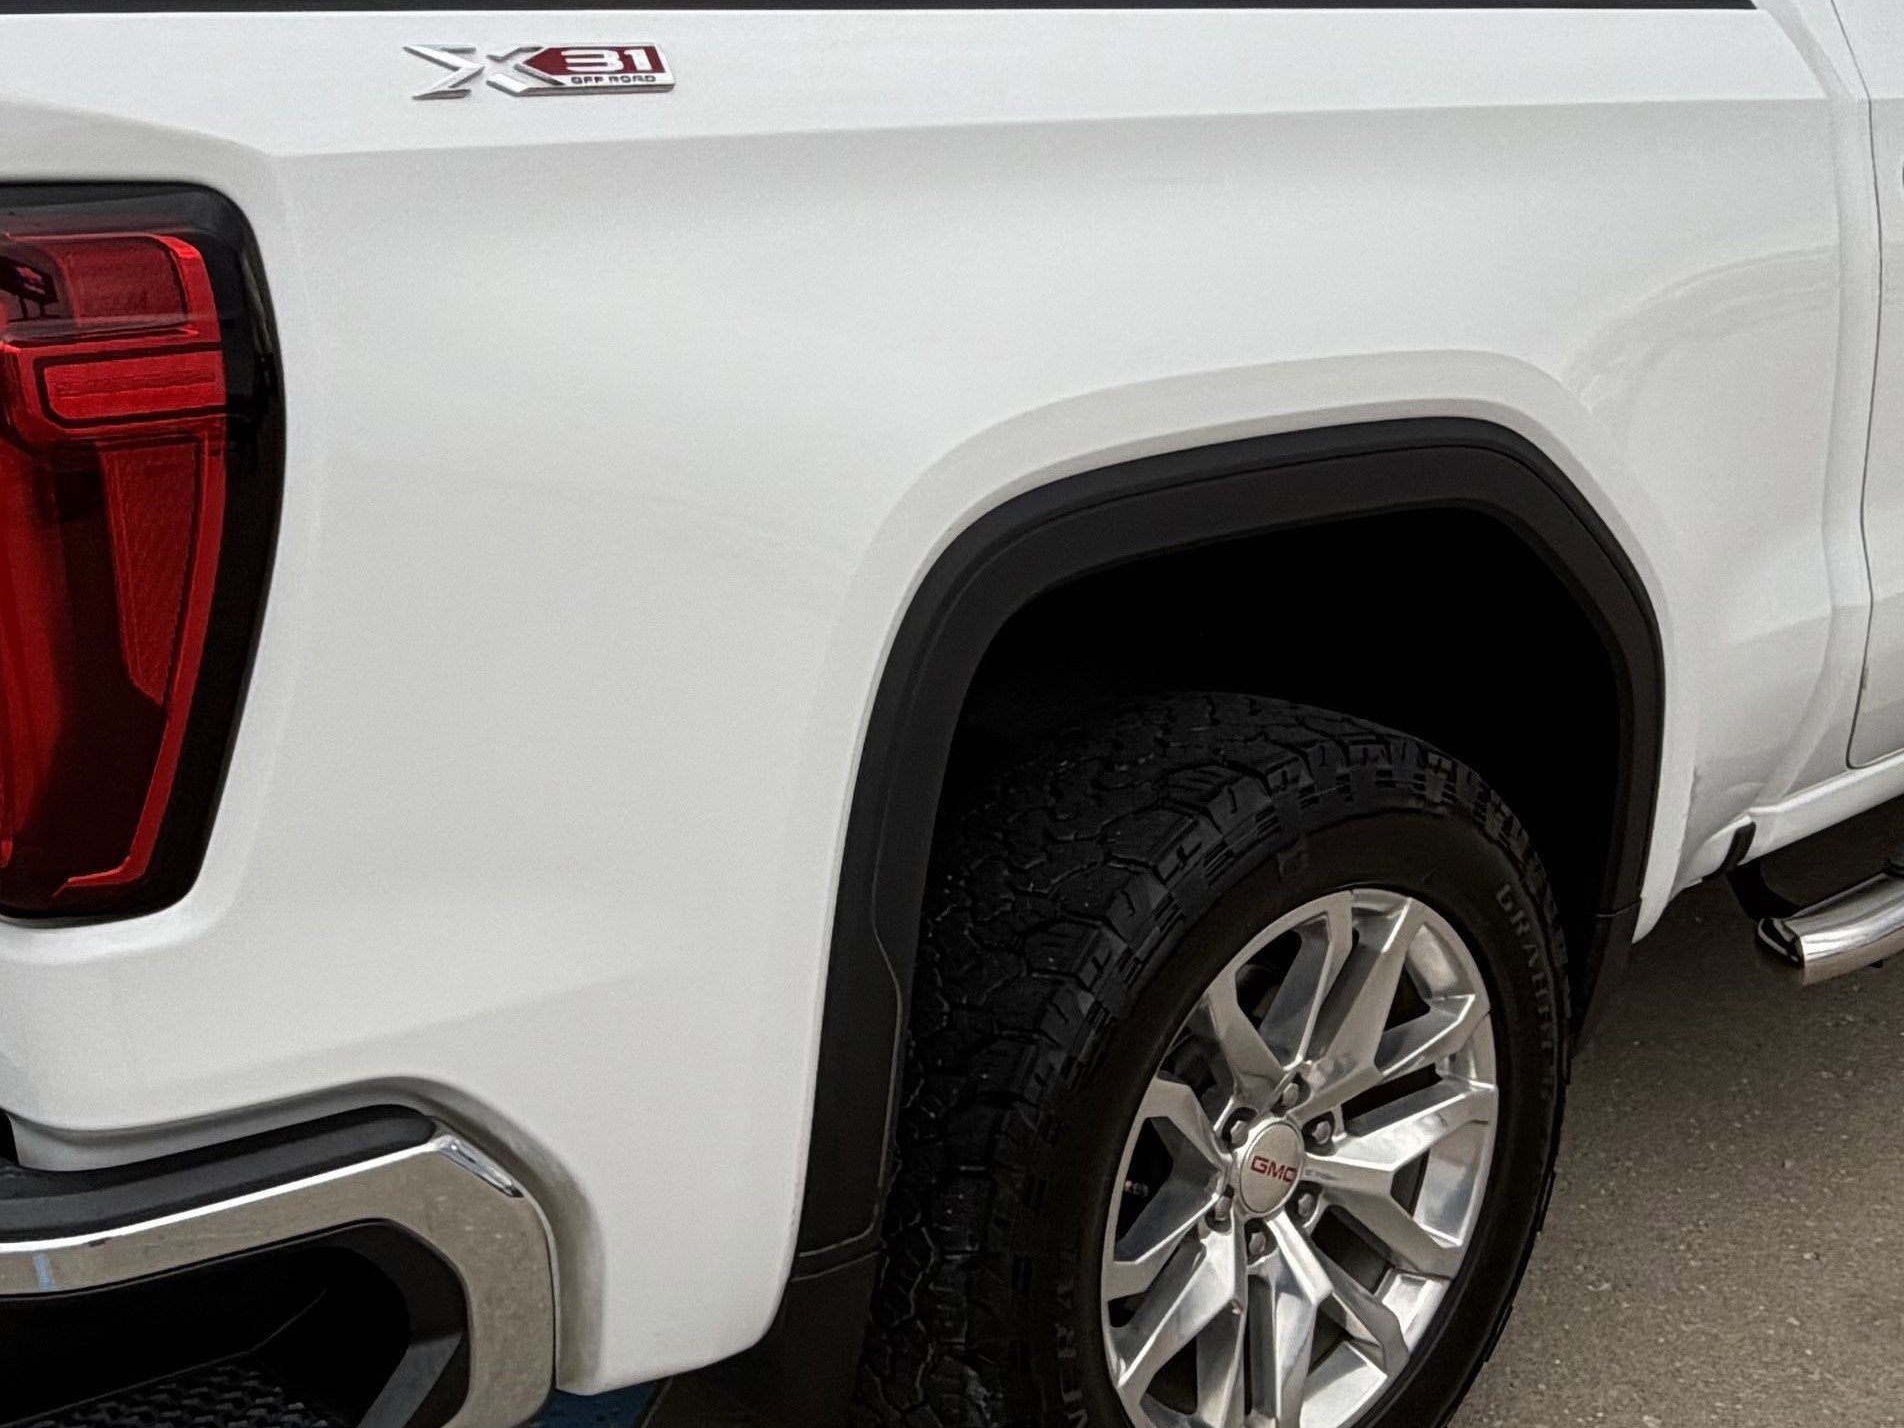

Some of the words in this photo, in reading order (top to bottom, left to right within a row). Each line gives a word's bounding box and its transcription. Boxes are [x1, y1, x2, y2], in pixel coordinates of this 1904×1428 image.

[570, 75, 605, 86] OFF
[608, 74, 657, 84] ROAD
[1249, 1154, 1298, 1184] GMC
